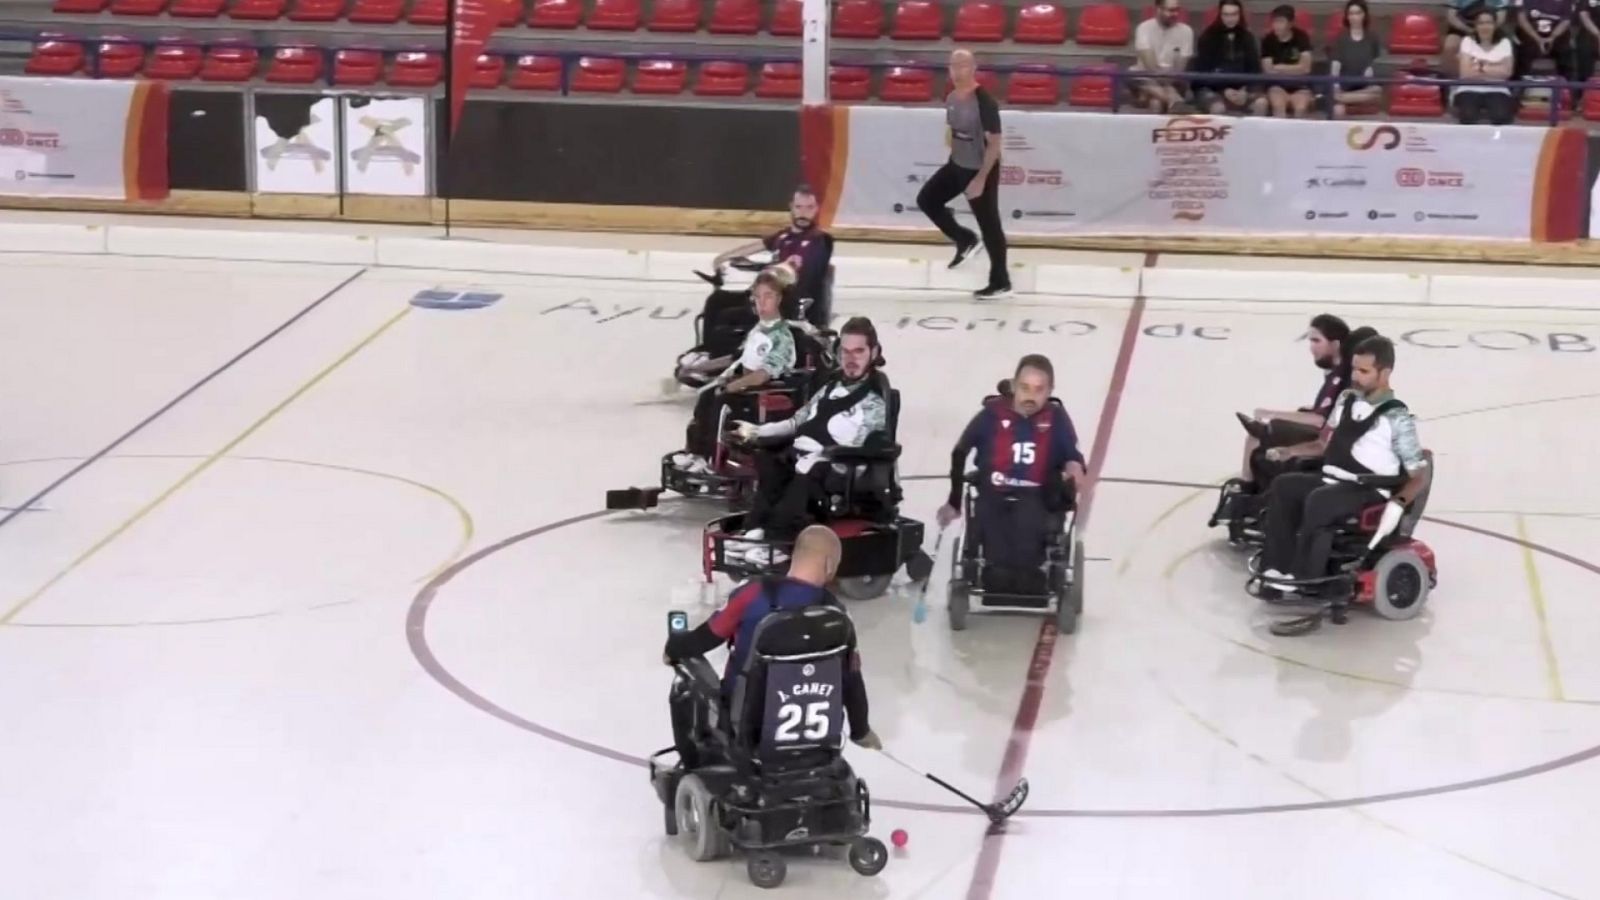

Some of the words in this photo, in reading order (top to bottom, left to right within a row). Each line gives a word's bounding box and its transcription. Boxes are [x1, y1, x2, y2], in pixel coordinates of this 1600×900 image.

[1152, 125, 1232, 143] FEDDF
[1143, 322, 1233, 340] de
[1012, 442, 1036, 464] 15
[792, 682, 834, 697] CANET
[774, 701, 830, 741] 25
